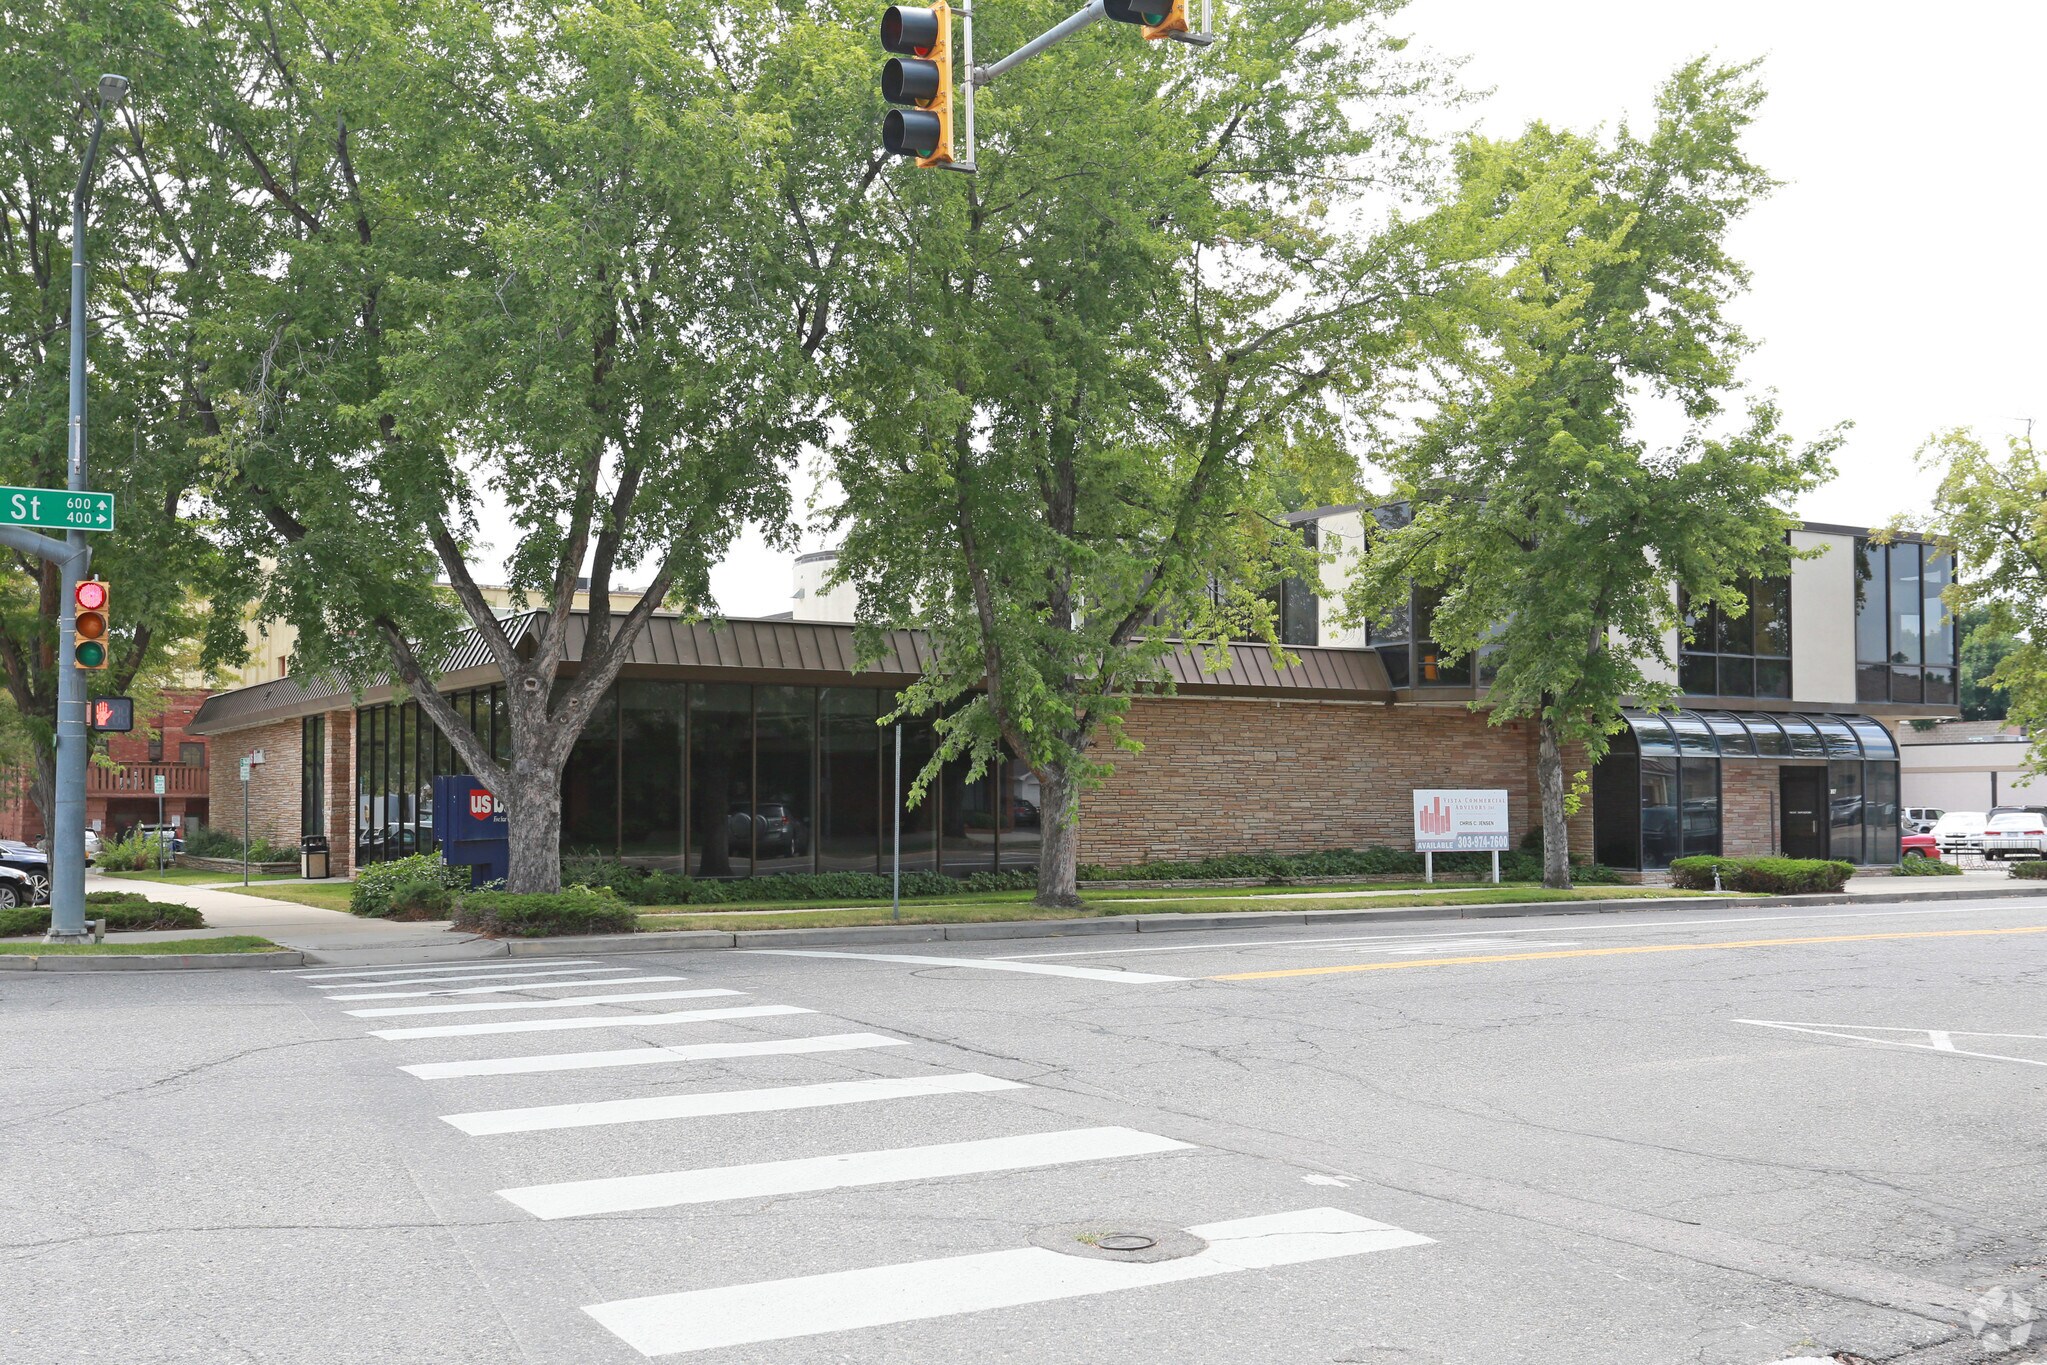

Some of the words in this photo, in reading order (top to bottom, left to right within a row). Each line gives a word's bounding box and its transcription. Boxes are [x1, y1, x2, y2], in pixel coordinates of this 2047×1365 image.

[10, 493, 41, 521] St
[66, 497, 91, 510] 600
[66, 511, 92, 524] 400
[1417, 841, 1454, 849] AVAILABLE
[1457, 835, 1508, 848] 303-974-7600
